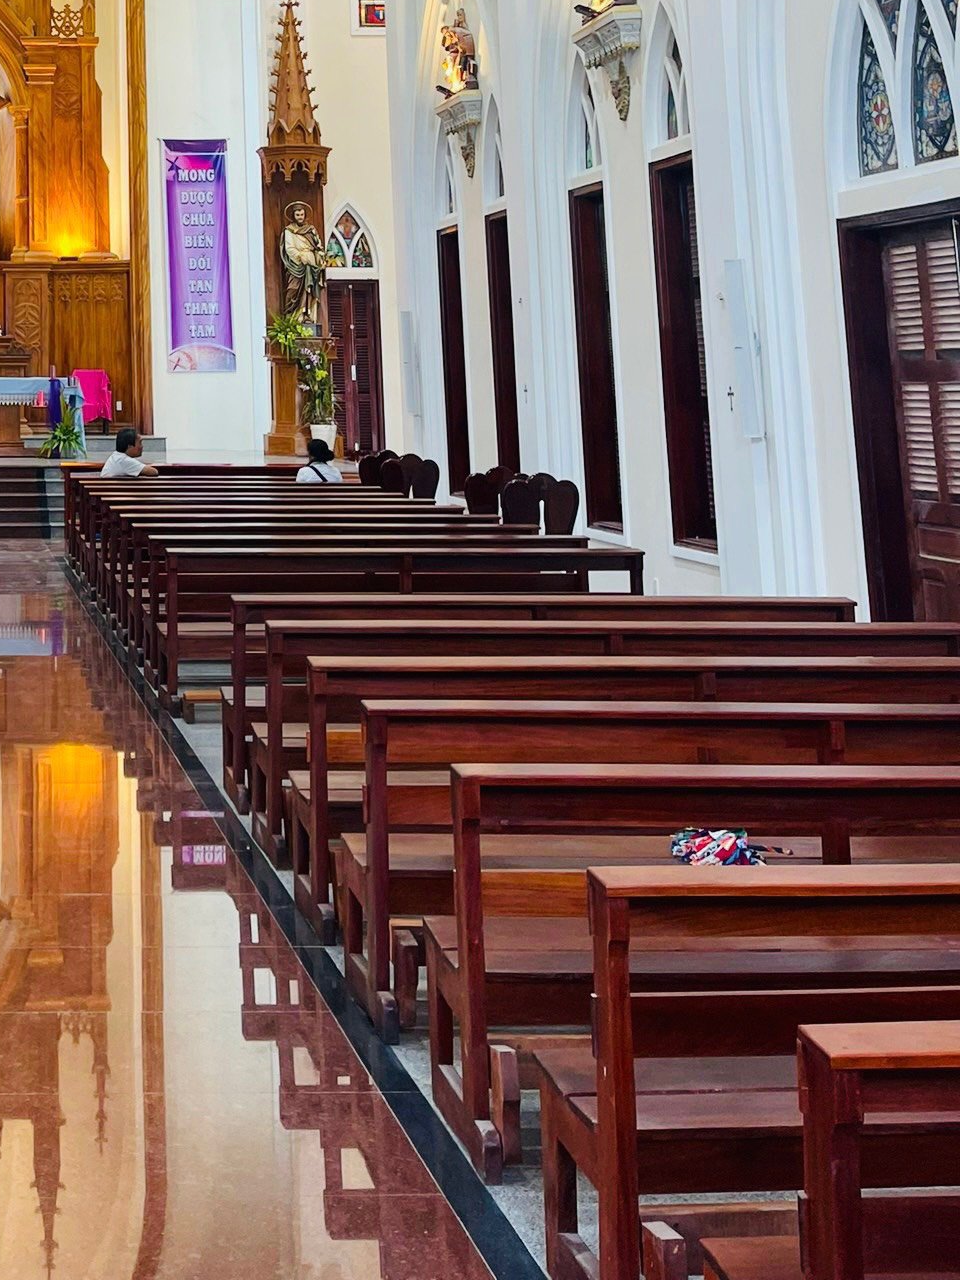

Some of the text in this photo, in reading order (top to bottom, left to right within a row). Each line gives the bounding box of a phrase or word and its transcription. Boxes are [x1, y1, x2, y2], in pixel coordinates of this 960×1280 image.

[177, 169, 215, 182] MONG
[183, 211, 214, 226] CHÚA
[185, 232, 214, 248] BIẾN
